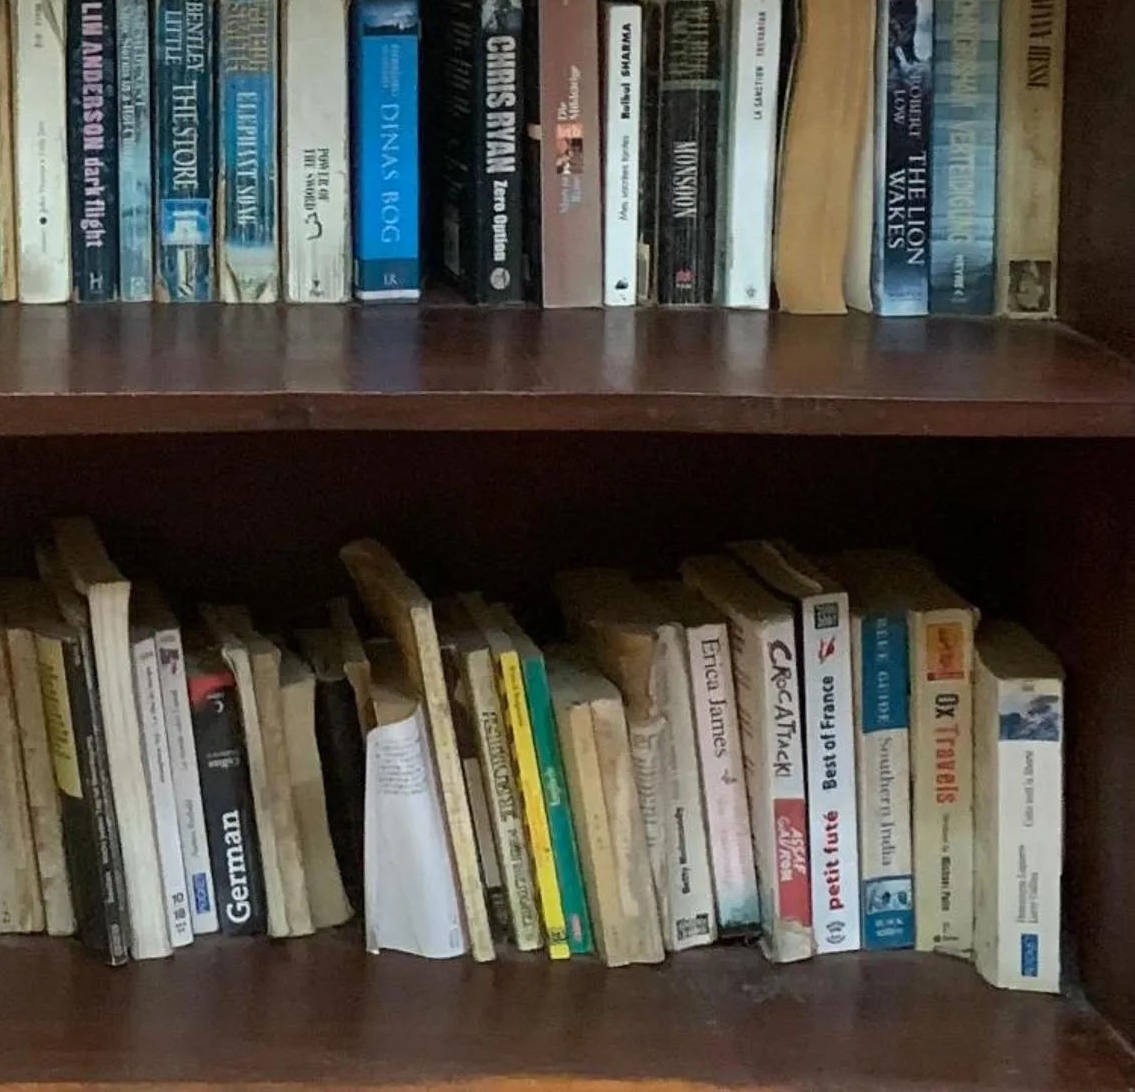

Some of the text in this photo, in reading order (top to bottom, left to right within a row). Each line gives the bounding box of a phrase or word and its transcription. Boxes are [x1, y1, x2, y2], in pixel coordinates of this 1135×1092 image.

[81, 1, 103, 36] LIN
[165, 9, 183, 67] LITTLE
[185, 1, 206, 73] BENTLEY
[620, 22, 633, 78] SHARMA
[82, 41, 105, 151] ANDERSON
[172, 80, 199, 191] THE STORE
[235, 91, 259, 177] ELEPHANT
[485, 35, 516, 174] CHRIS RYAN
[753, 109, 764, 121] LA
[892, 88, 907, 125] LOW
[84, 157, 105, 196] dark
[303, 147, 317, 211] THE SWORD
[316, 147, 330, 186] POWER
[380, 103, 401, 244] DINAS BOG
[672, 140, 699, 220] MONSOON
[80, 198, 106, 248] flight
[492, 179, 509, 262] Zero Option
[887, 168, 907, 250] WAKES
[906, 150, 927, 266] THE LION
[701, 637, 727, 758] Erica James
[933, 693, 960, 804] Ox Travels
[819, 675, 844, 911] petit futé Best of France
[877, 736, 896, 867] Southern India
[222, 810, 252, 925] German
